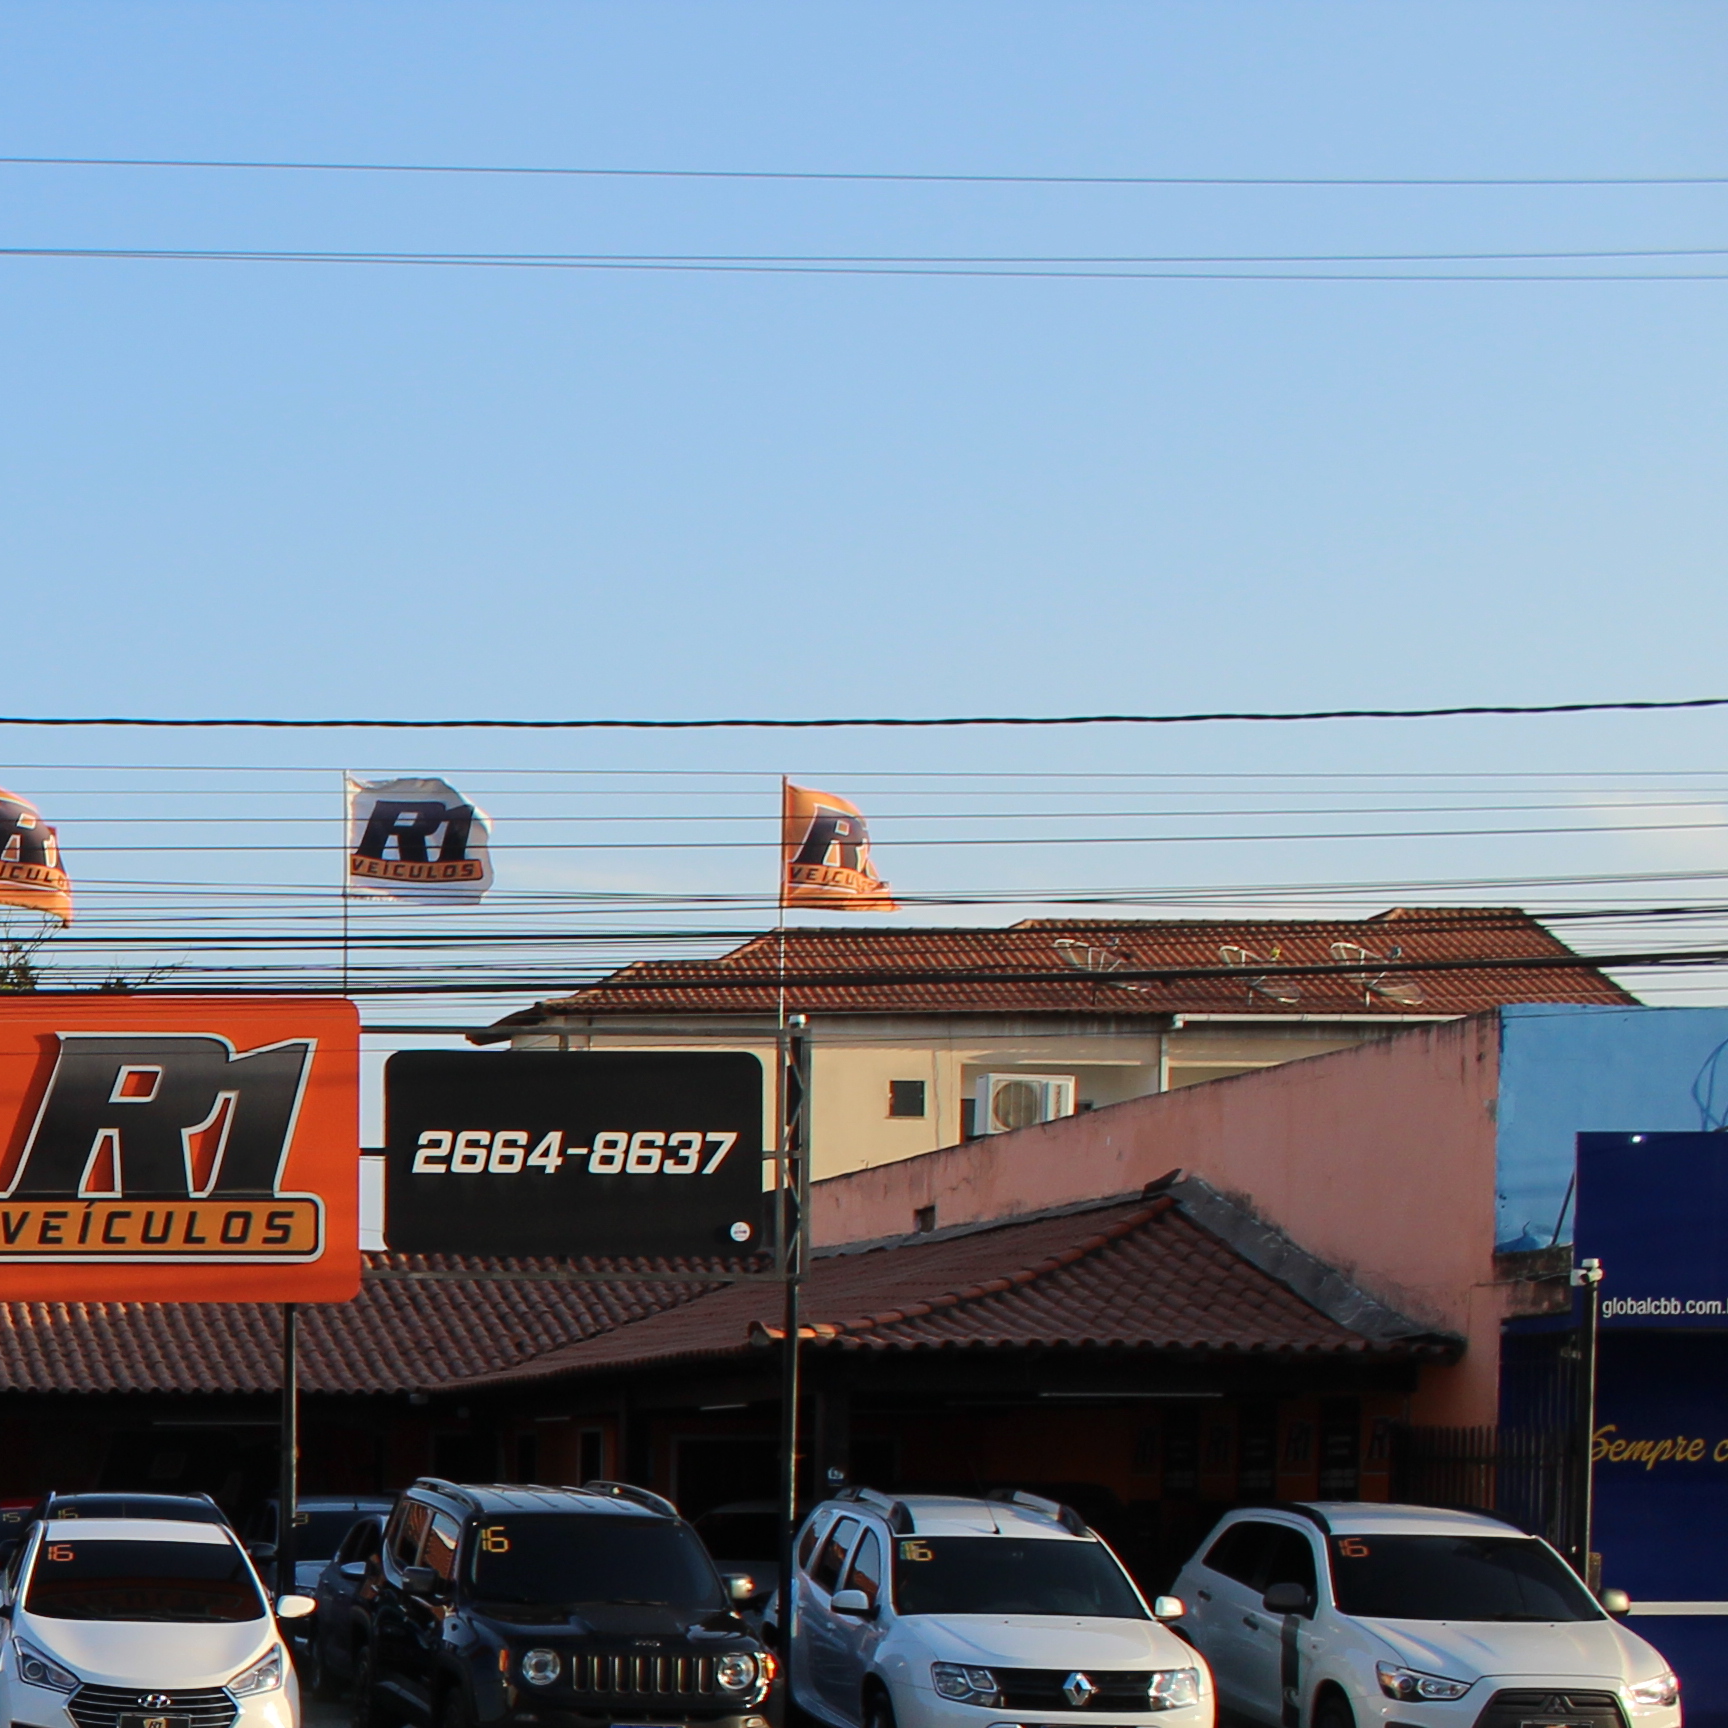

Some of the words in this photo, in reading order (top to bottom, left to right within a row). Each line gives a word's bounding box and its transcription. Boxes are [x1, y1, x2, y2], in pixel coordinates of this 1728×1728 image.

[355, 799, 474, 862] R1
[9, 1032, 317, 1198] R1
[412, 1130, 739, 1174] 2664-8637
[1, 1200, 296, 1245] VEÍCULOS
[1602, 1297, 1728, 1318] globalcbb.com.
[48, 1543, 76, 1562] 16
[481, 1526, 510, 1553] 16
[903, 1540, 934, 1561] 16
[1338, 1537, 1371, 1558] 16
